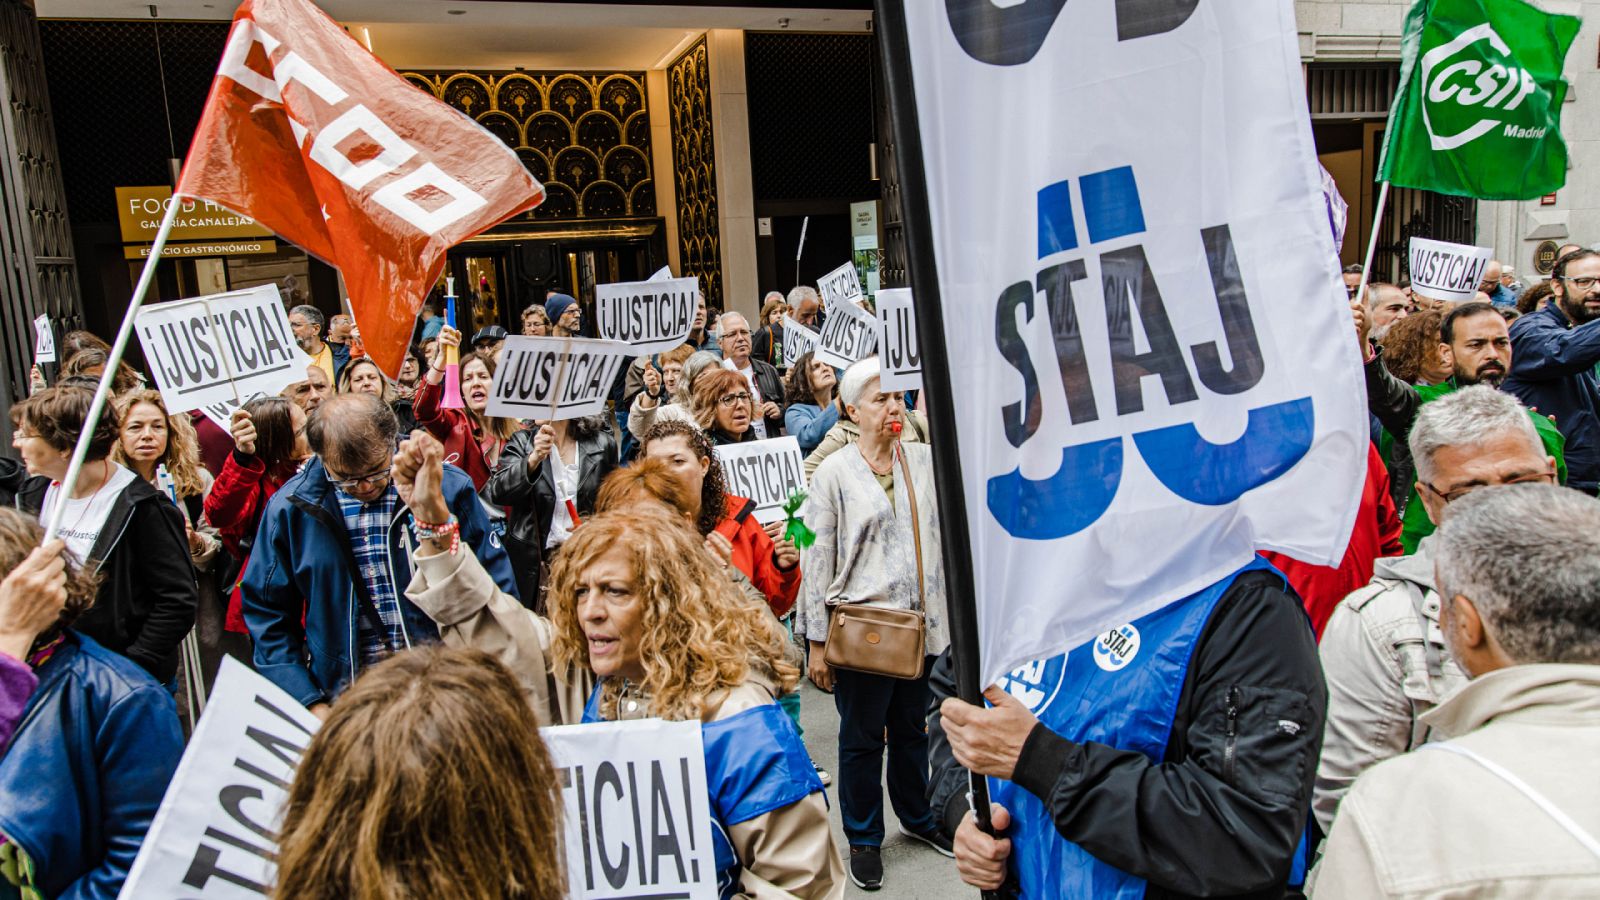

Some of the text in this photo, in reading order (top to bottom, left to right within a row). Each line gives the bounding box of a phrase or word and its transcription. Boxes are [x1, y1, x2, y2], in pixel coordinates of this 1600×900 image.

[1504, 124, 1546, 139] Madrid
[141, 216, 254, 229] GALRÍA CANALEJAS
[140, 243, 261, 256] ESACIO GASTRONÓMICO
[602, 291, 694, 342] ¡JUSTICIA!
[995, 224, 1264, 448] STAJ
[1104, 629, 1133, 659] STAJ
